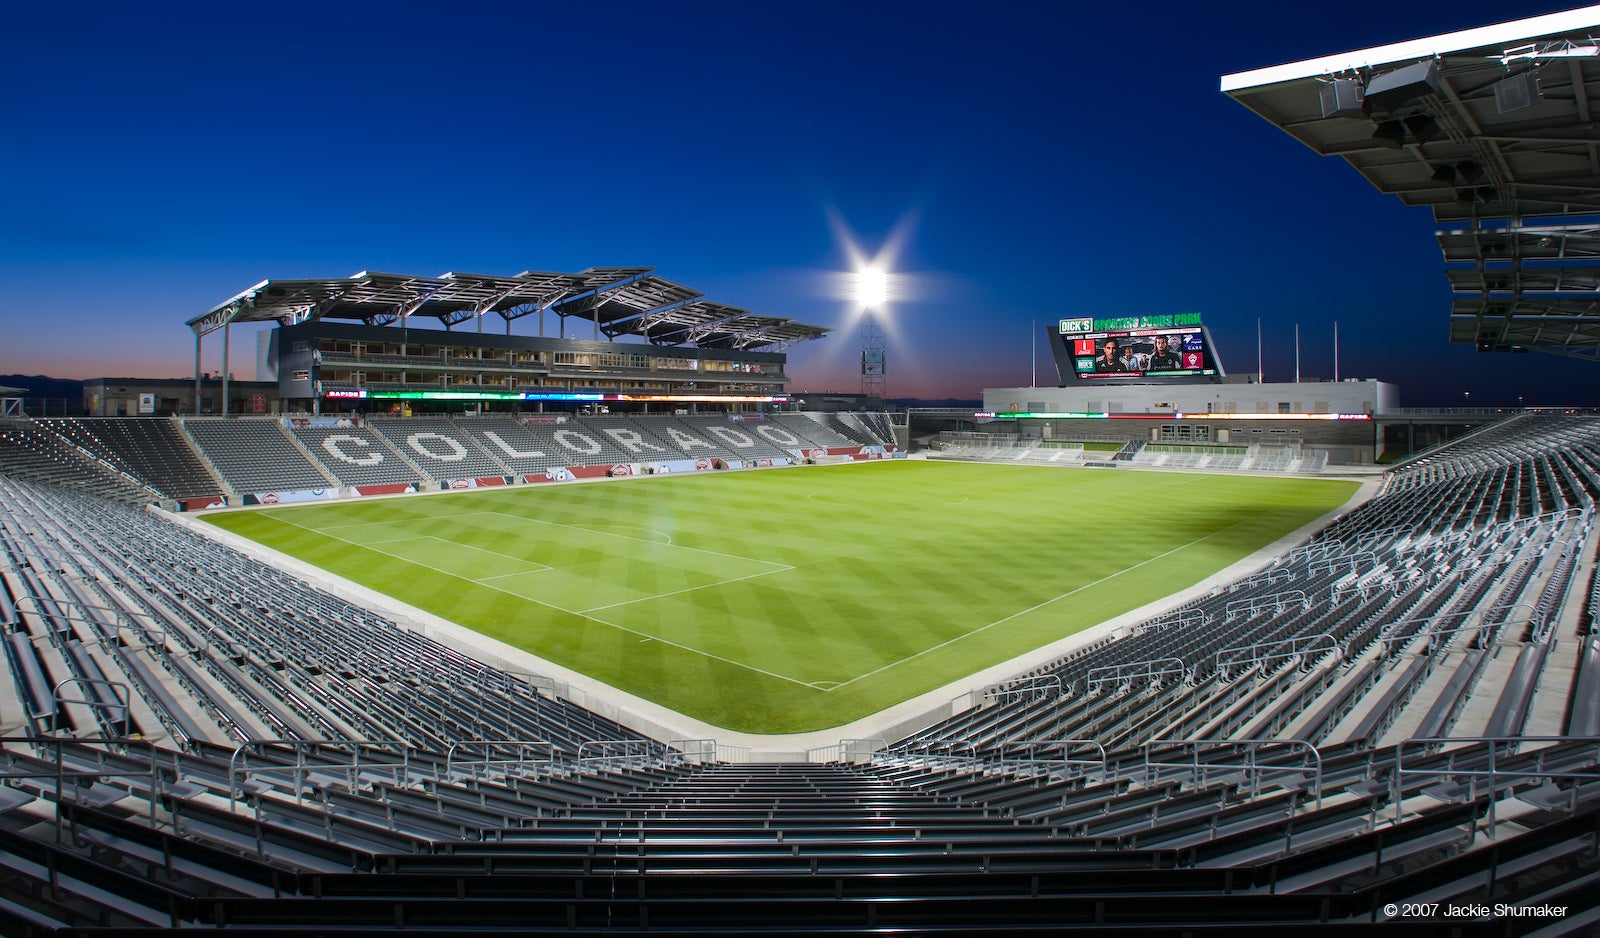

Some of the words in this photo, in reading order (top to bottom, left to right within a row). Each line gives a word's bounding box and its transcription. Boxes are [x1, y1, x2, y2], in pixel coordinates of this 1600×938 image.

[1061, 320, 1090, 332] DICK'S
[1140, 314, 1173, 327] GOODS
[1174, 312, 1202, 325] PARK
[321, 424, 800, 467] COLORADO
